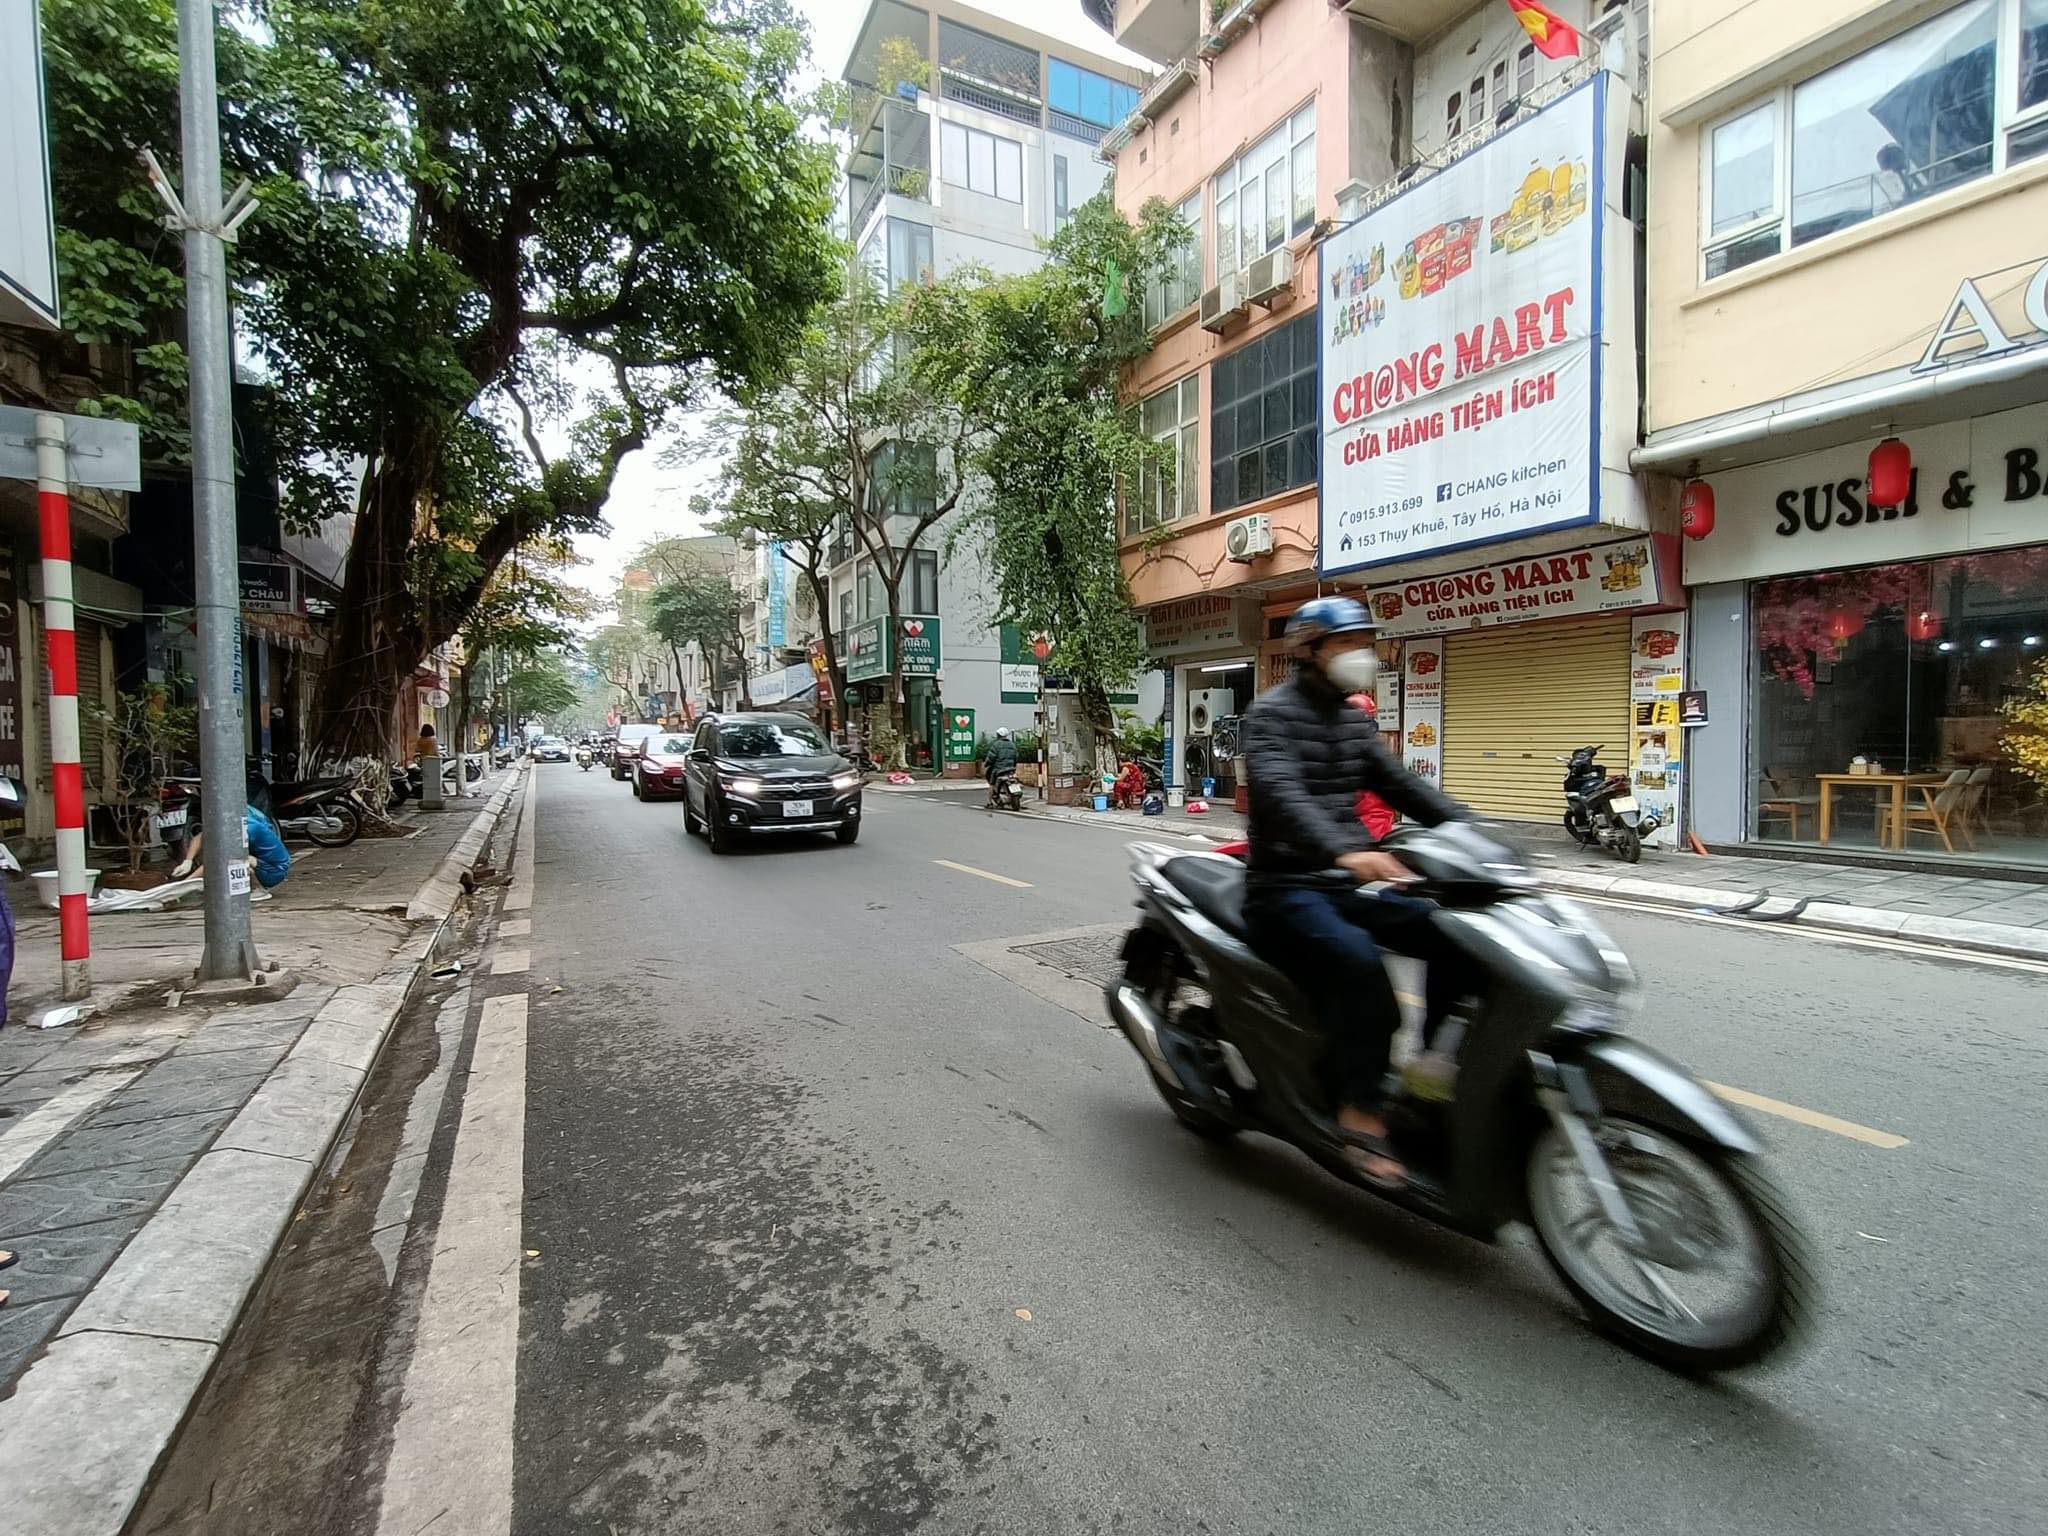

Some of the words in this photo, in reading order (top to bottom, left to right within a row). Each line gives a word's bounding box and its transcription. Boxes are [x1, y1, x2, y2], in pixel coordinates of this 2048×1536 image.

[1333, 343, 1445, 424] CH@NG
[1453, 287, 1574, 380] MART
[1344, 428, 1381, 466] CỬA
[1387, 412, 1444, 453] HÀNG
[1451, 390, 1503, 432] TIỆN
[1511, 371, 1558, 413] ÍCH
[1456, 473, 1507, 497] CHANG
[1512, 458, 1566, 483] kitchen
[1942, 470, 1976, 510] &
[2004, 447, 2048, 502] B
[1349, 495, 1423, 525] 0915.913.699
[1358, 534, 1376, 548] 153
[1379, 527, 1408, 544] Thụy
[1412, 519, 1448, 536] Khuê,
[1453, 511, 1477, 528] Tây
[1510, 498, 1530, 514] Hà
[1535, 489, 1562, 508] Nội
[249, 588, 284, 600] CHÂU
[1404, 571, 1496, 607] CH@NG
[1502, 551, 1593, 592] MART
[1427, 604, 1455, 622] CỬA
[1459, 599, 1500, 617] HÀNG
[1503, 594, 1540, 612] TIỆN
[1544, 588, 1574, 603] ÍCH
